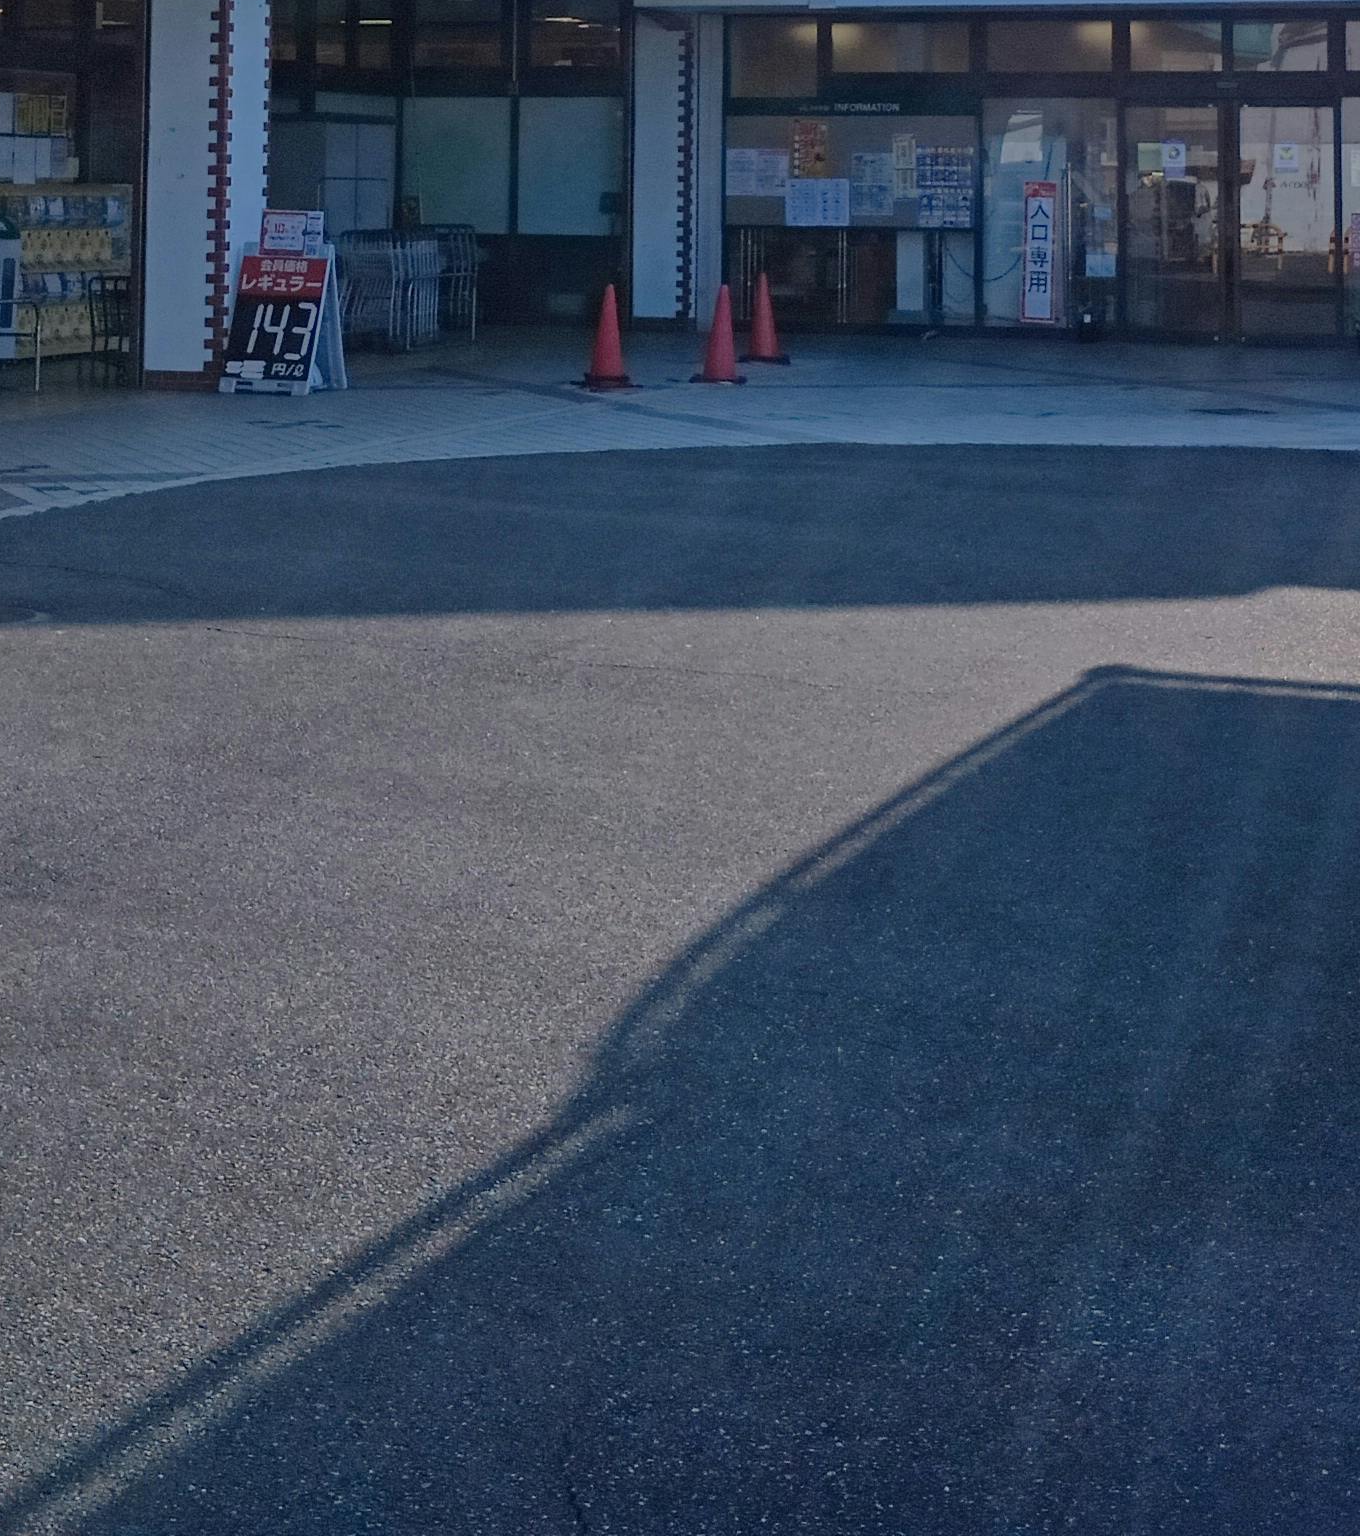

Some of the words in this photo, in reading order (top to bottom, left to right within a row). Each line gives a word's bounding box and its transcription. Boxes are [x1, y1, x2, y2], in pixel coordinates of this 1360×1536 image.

[833, 102, 900, 112] INFORMATION
[1027, 201, 1051, 294] 入口専用
[259, 259, 308, 273] 会員価格
[240, 273, 322, 292] レギュラー
[246, 301, 318, 361] 143
